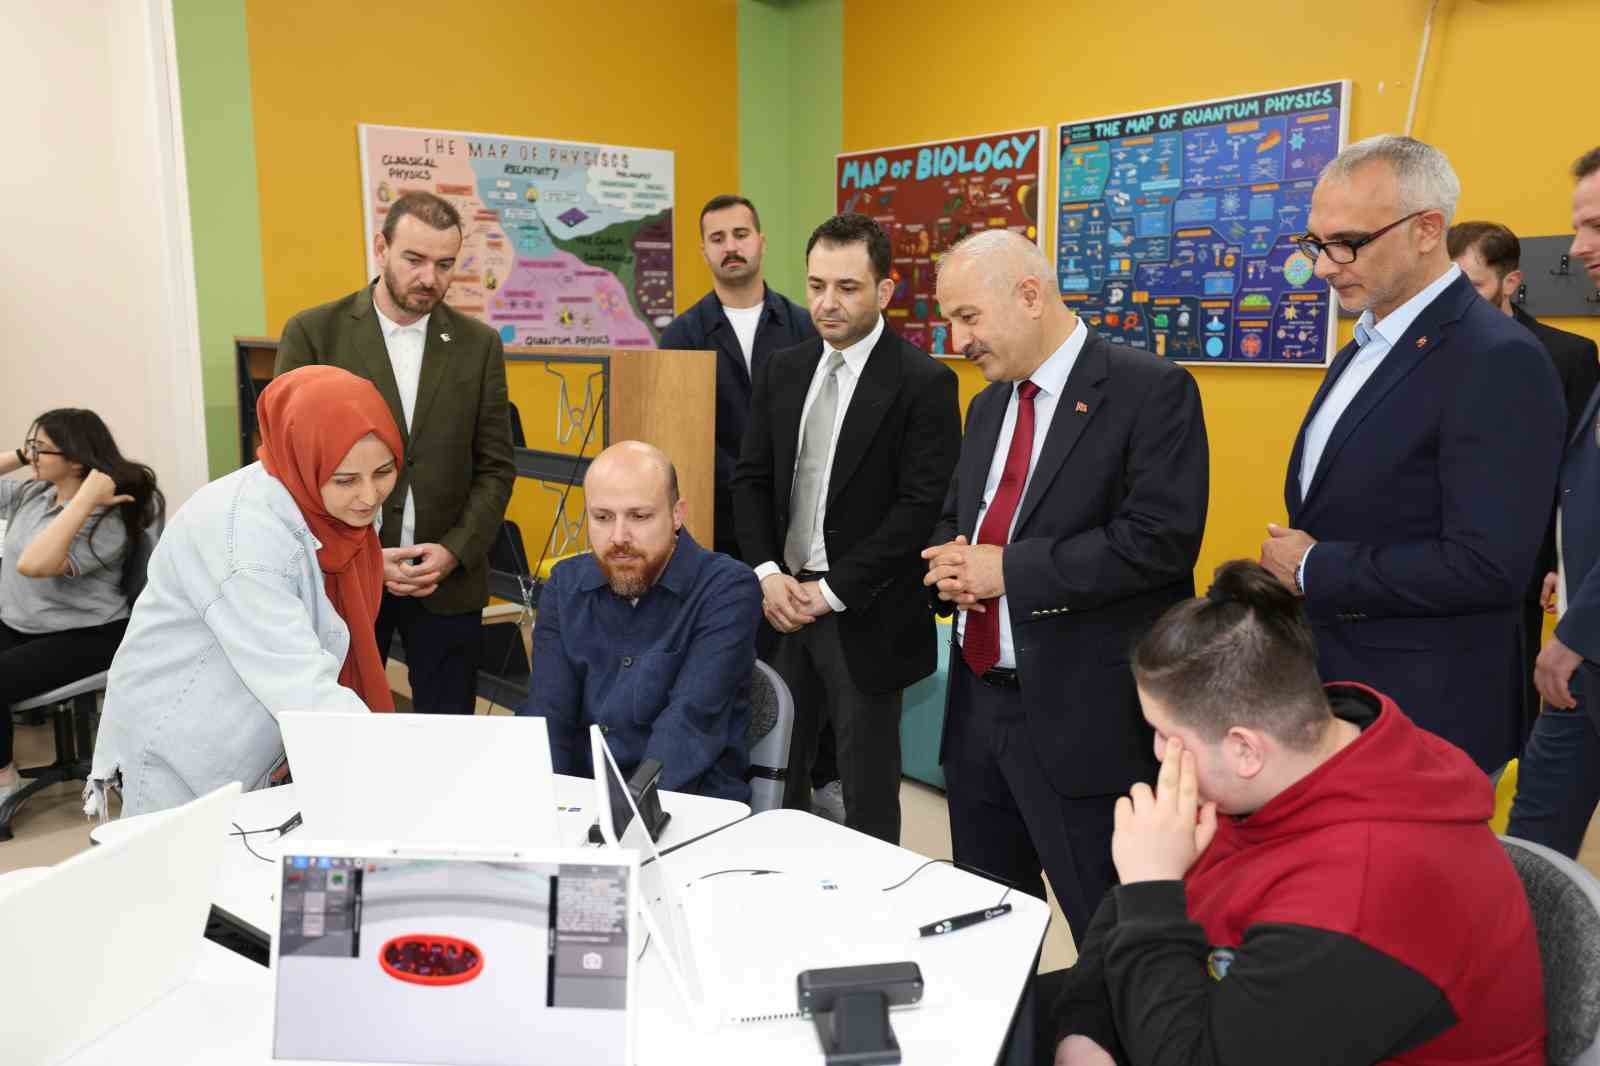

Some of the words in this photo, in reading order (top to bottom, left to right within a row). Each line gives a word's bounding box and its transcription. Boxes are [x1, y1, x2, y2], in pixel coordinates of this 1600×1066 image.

[1094, 121, 1120, 138] THE
[1125, 116, 1154, 134] MAP
[1158, 112, 1177, 130] OF
[1182, 100, 1260, 125] QUANTUM
[1264, 88, 1333, 114] PHYSICS
[424, 137, 456, 156] THE
[467, 142, 509, 160] MAP
[519, 144, 538, 161] OF
[382, 154, 438, 168] CLASSICAL
[840, 155, 888, 189] MAP
[915, 133, 1037, 181] BIOLOGY
[388, 167, 431, 181] PHYSICS
[504, 163, 560, 181] RELATIVITY
[524, 335, 573, 346] QUANTUM
[575, 334, 609, 346] PHYSICS
